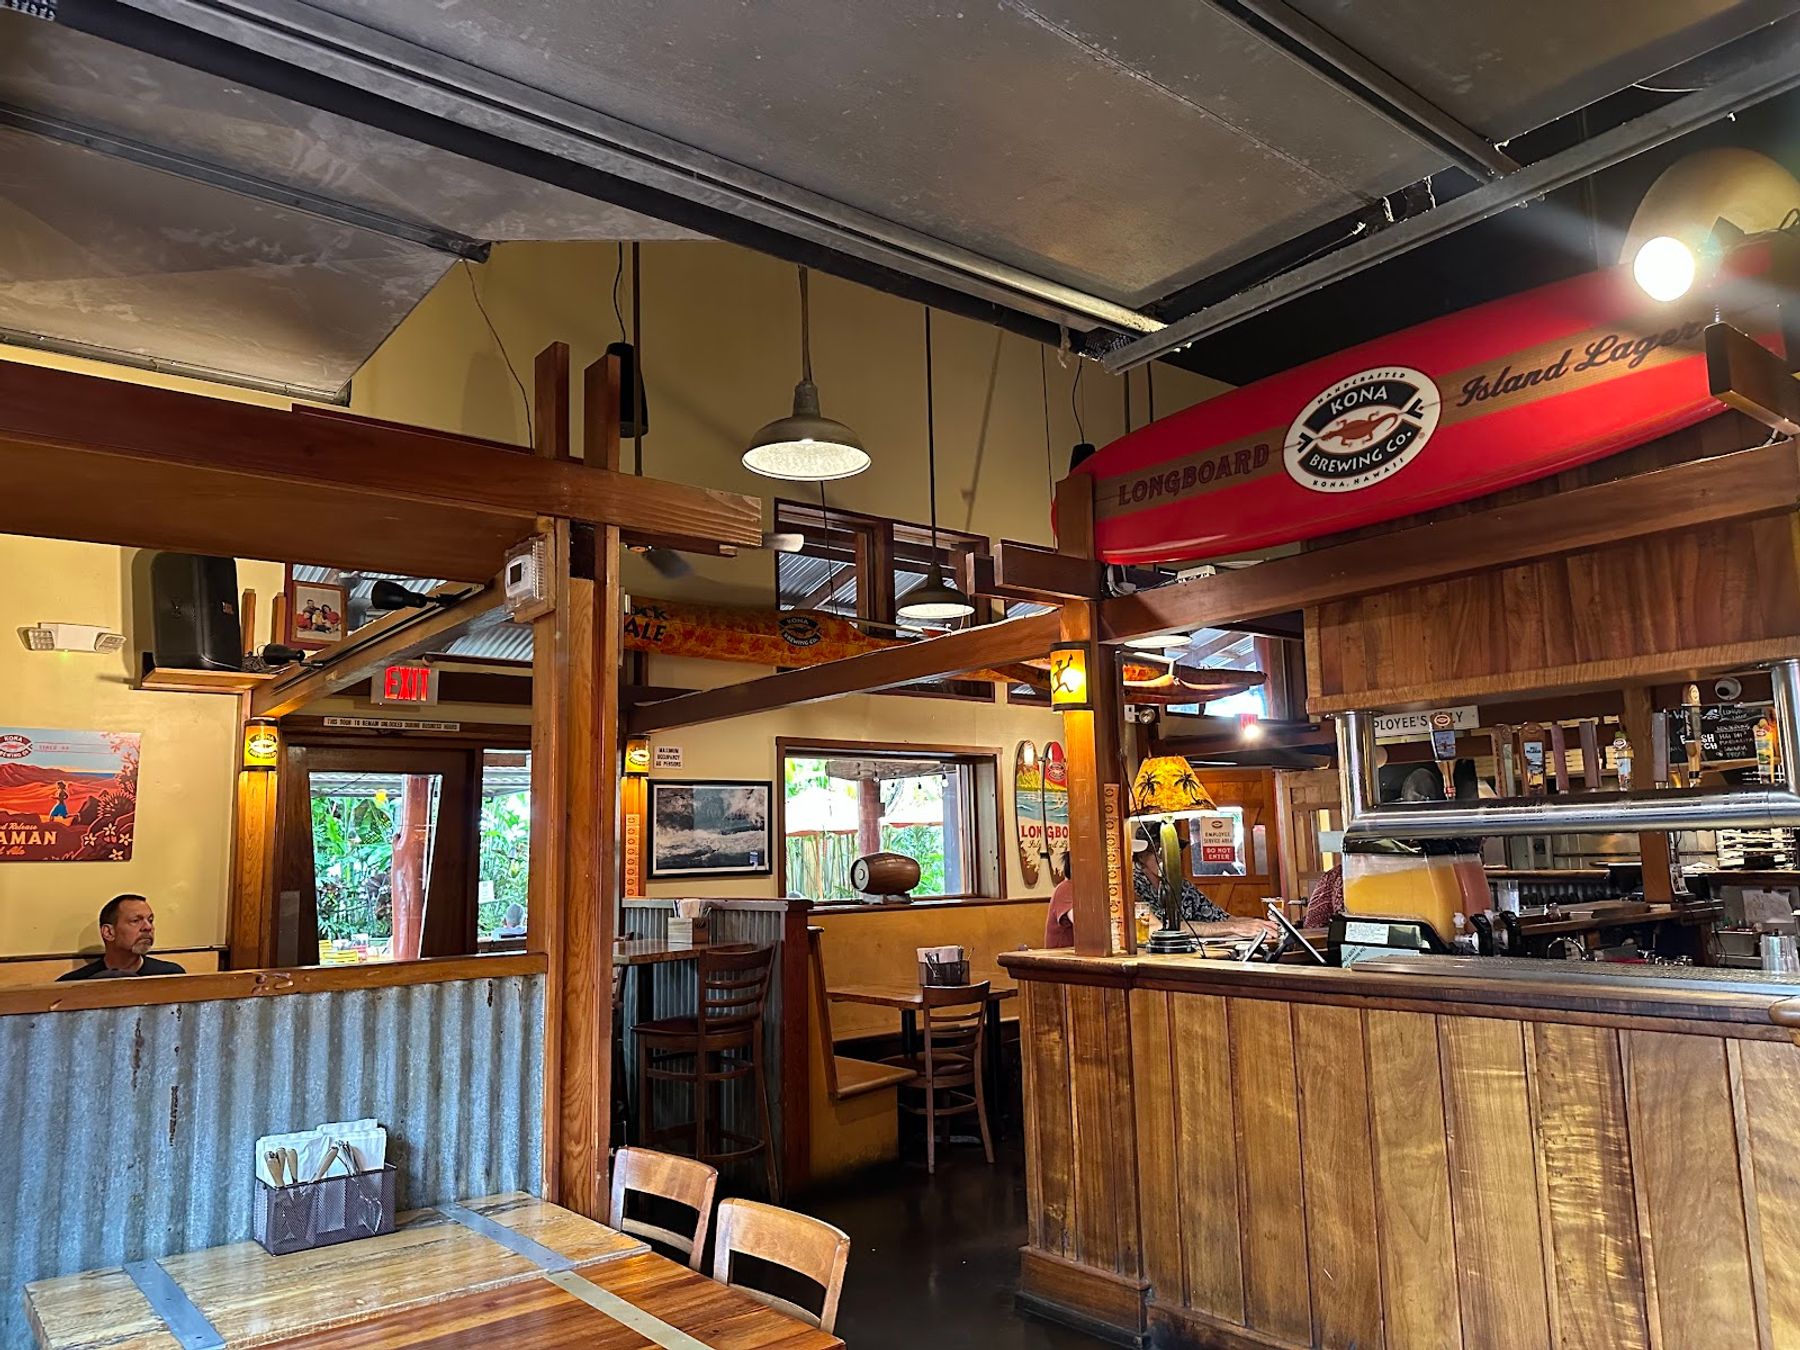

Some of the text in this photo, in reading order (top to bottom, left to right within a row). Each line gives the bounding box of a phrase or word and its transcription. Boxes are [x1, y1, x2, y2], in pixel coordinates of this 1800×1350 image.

[1457, 321, 1705, 407] Island Lager
[1317, 372, 1406, 404] HANDCRAFTED
[1331, 385, 1388, 415] KONA
[1309, 431, 1412, 473] BREWING CO.
[1118, 443, 1270, 506] LONGBOARD
[1312, 457, 1404, 488] KONA, HAWAII
[786, 617, 809, 625] KONA
[384, 666, 431, 701] EXIT
[1374, 715, 1428, 731] PLOYEE'S
[0, 831, 57, 845] AMAN
[1021, 825, 1068, 840] LONGBO
